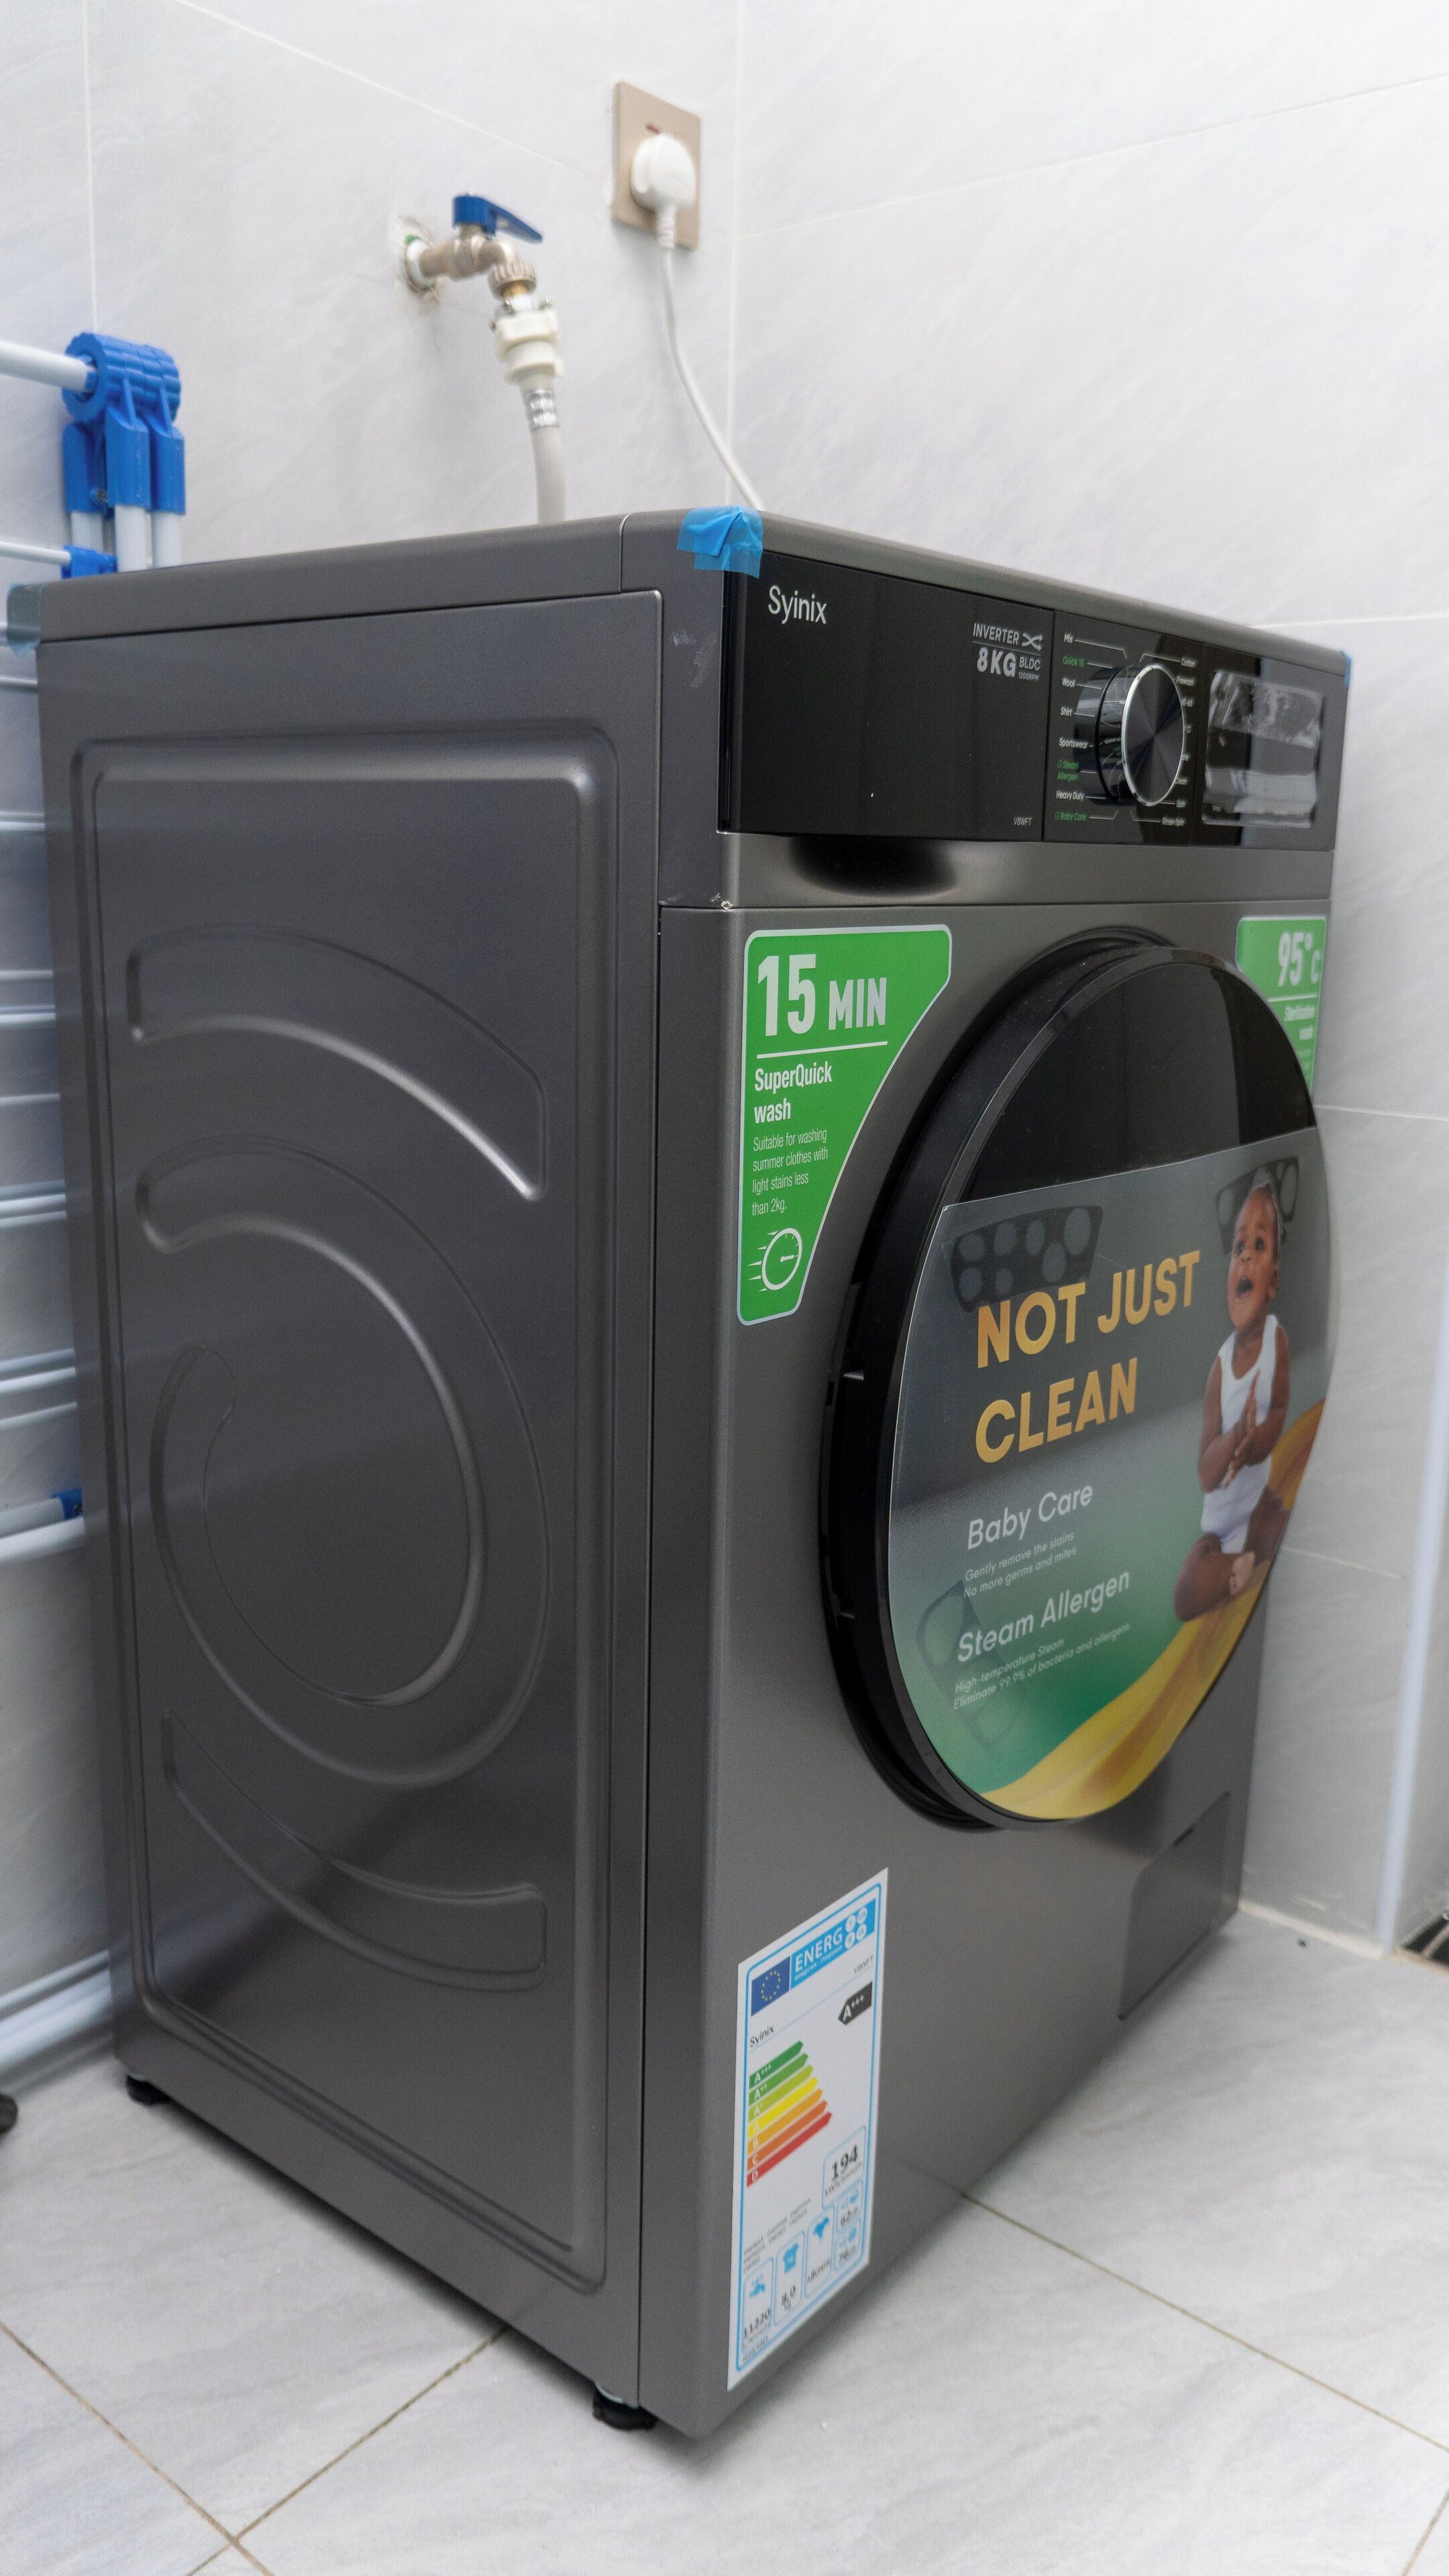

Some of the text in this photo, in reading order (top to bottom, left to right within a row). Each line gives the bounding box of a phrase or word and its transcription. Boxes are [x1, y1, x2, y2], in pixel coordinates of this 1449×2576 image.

[767, 584, 827, 625] Syinix
[973, 623, 1020, 645] INVERTER
[1063, 633, 1073, 643] Mix
[1019, 657, 1040, 671] BLDC
[1018, 672, 1040, 682] 1200RPM
[1062, 677, 1075, 688] Wool
[1060, 706, 1072, 716] Shirt
[1059, 738, 1088, 749] Sportswear
[1063, 760, 1079, 770] Steam
[1057, 772, 1079, 783] Allergen
[1056, 790, 1084, 802] Heavy Duty
[1060, 811, 1073, 822] Baby
[757, 953, 888, 1037] 15 MIN
[754, 1061, 833, 1091] SuperQuick
[754, 1097, 791, 1124] wash
[753, 1128, 827, 1151] Suitable for washing
[753, 1146, 828, 1172] summer clothes with
[752, 1172, 809, 1195] light stains less
[751, 1197, 787, 1216] than 2kg.
[977, 1250, 1201, 1368] NOT JUST
[975, 1357, 1138, 1463] CLEAN
[967, 1485, 1093, 1550] Baby Care
[965, 1532, 1075, 1581] Gently remove the stains
[964, 1547, 1077, 1599] No more germs and mites
[958, 1572, 1130, 1662] Steam Allergen
[953, 1682, 996, 1711] Eliminate
[1027, 1663, 1038, 1676] of
[1038, 1648, 1073, 1670] bacteria
[1075, 1638, 1092, 1654] and
[1094, 1622, 1131, 1646] allergens
[955, 1639, 1065, 1693] High-temperature Steam
[795, 1927, 843, 1972] ENERG
[749, 2025, 775, 2047] Syinix
[832, 2144, 858, 2181] 194
